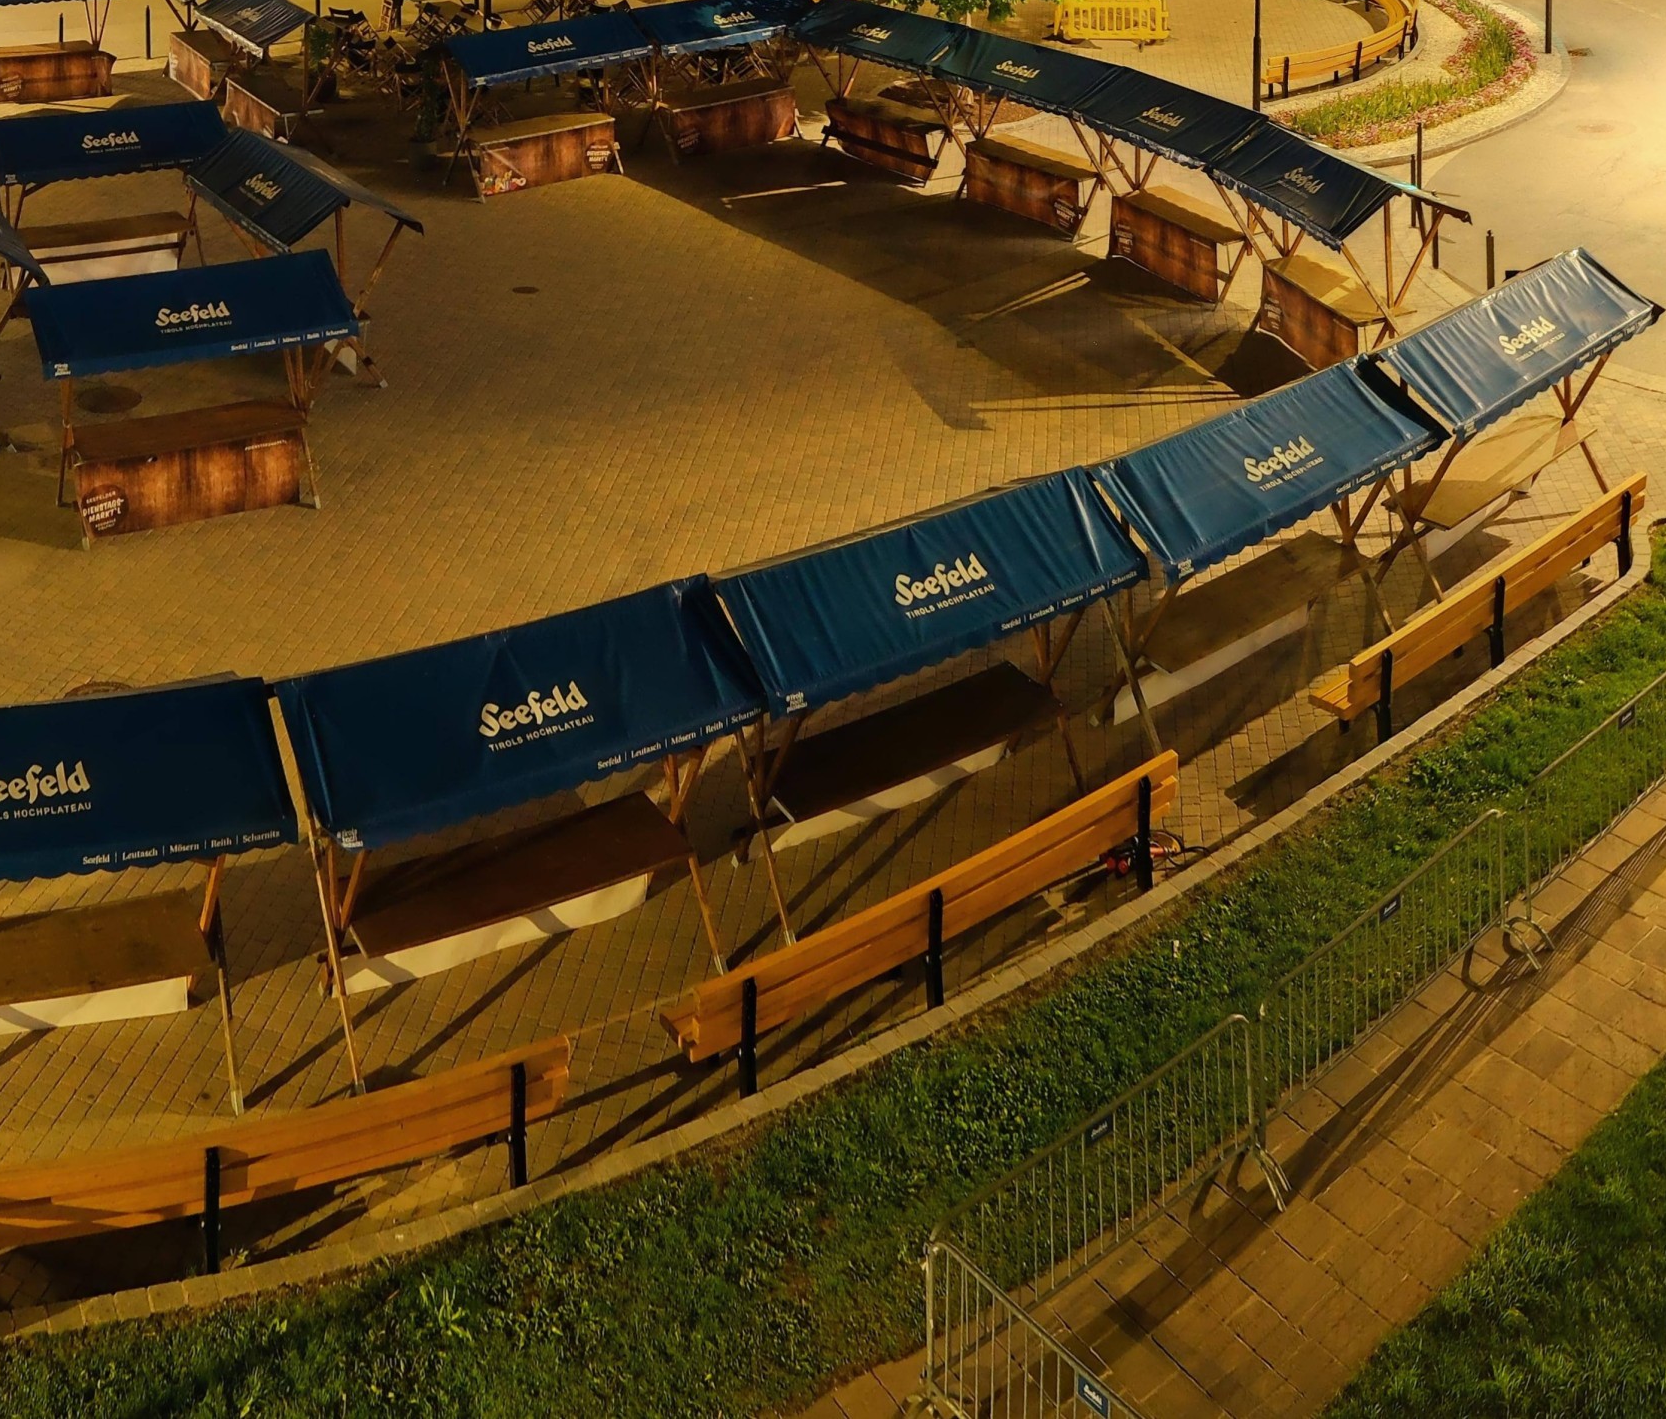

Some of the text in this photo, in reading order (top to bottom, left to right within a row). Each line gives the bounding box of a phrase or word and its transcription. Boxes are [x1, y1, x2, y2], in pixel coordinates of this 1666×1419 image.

[713, 11, 756, 25] Seefeld
[528, 36, 573, 53] Seefeld
[995, 61, 1040, 79] Seefeld
[82, 132, 140, 149] Seefeld
[155, 301, 231, 328] Seefeld
[1498, 316, 1556, 355] Seefeld
[1244, 436, 1315, 482] Seefeld
[895, 553, 988, 607] Seefeld
[479, 681, 588, 738] Seefeld
[489, 715, 595, 752] TIROLS HOCHPLATEAU
[14, 801, 92, 818] HOCHPLATEAU
